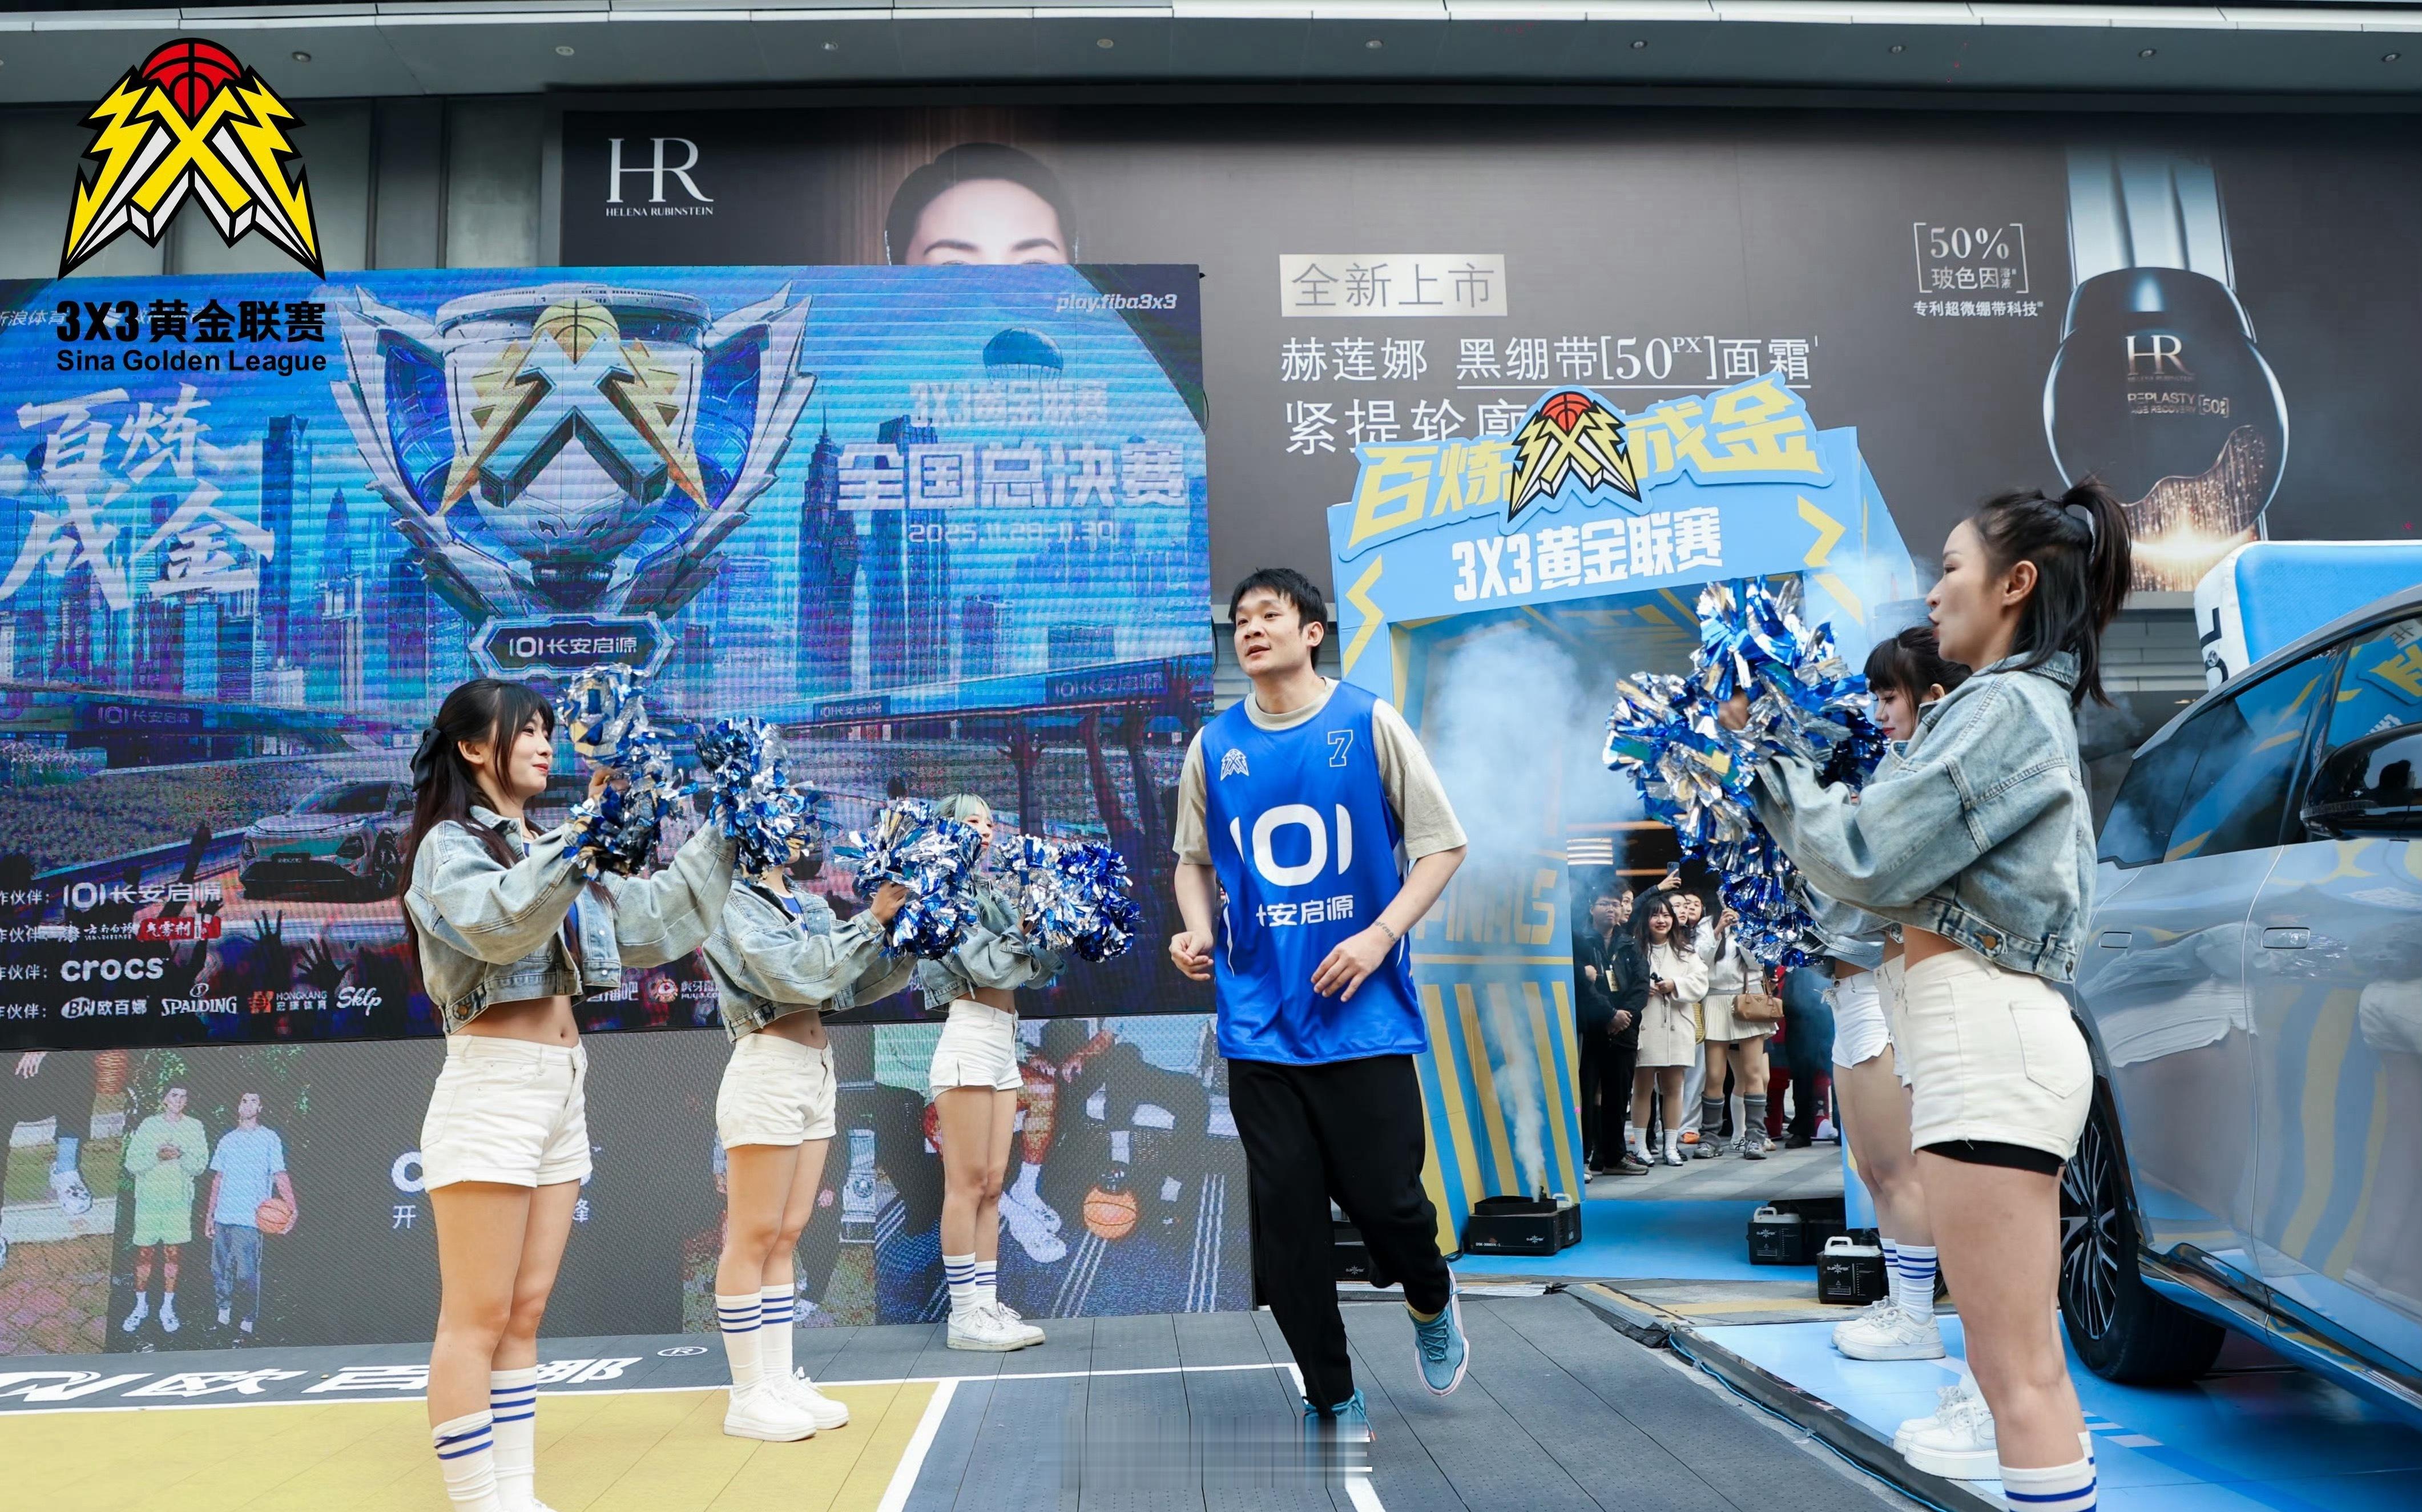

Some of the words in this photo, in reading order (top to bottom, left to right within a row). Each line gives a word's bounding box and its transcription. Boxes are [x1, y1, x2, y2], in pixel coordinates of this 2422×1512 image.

[606, 137, 714, 203] HR
[606, 207, 648, 217] HELENA
[650, 206, 714, 216] RUBINSTEIN
[1056, 293, 1178, 313] play.fiba3x3
[1291, 263, 1494, 308] 全新上市
[1281, 336, 1428, 382] 赫莲娜
[2125, 334, 2197, 376] HR
[17, 381, 212, 484] 百炼
[837, 438, 1188, 511] 全国总决赛
[1348, 440, 1518, 549] 百炼
[1625, 377, 1824, 480] 成金
[0, 478, 275, 611] 成金
[1452, 506, 1723, 602] 3X3黄金联赛
[1327, 729, 1353, 768] 7
[60, 957, 164, 982] crocs
[161, 996, 237, 1017] SPALDING
